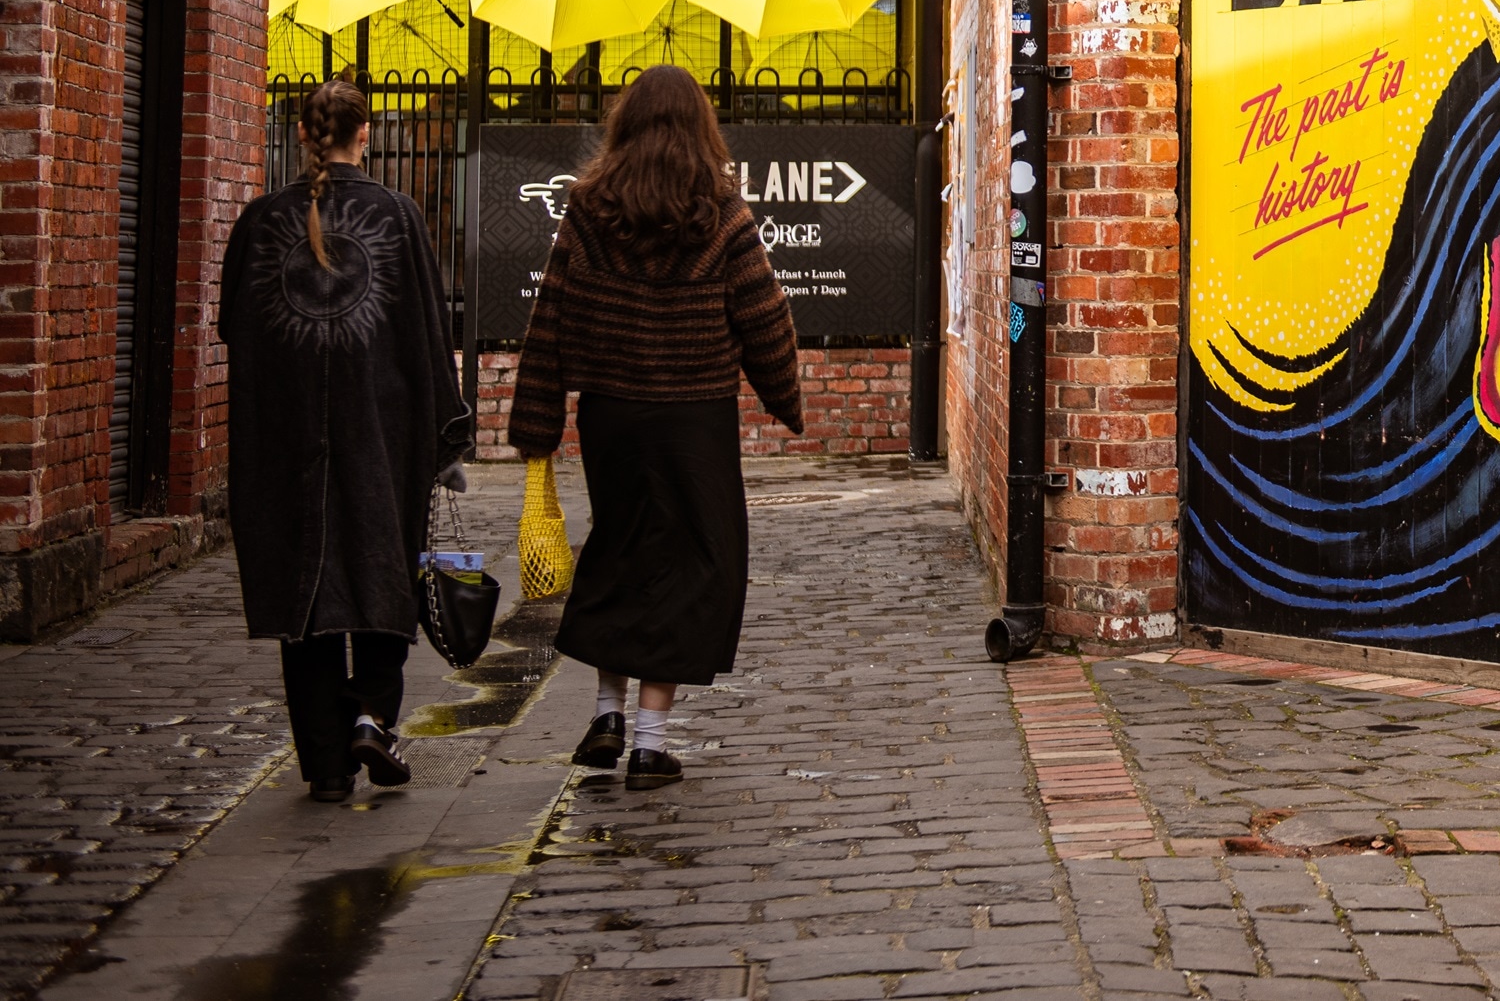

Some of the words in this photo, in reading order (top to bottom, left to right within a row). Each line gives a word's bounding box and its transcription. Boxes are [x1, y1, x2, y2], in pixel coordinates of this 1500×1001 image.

[1240, 83, 1290, 164] The
[1289, 47, 1388, 162] past
[1379, 60, 1406, 103] is
[1254, 151, 1361, 230] history
[755, 222, 822, 246] ORGE
[773, 269, 802, 279] kfast
[811, 268, 846, 280] Lunch
[521, 288, 532, 297] to
[781, 285, 809, 298] Open
[812, 285, 818, 295] 7
[821, 285, 847, 297] Days
